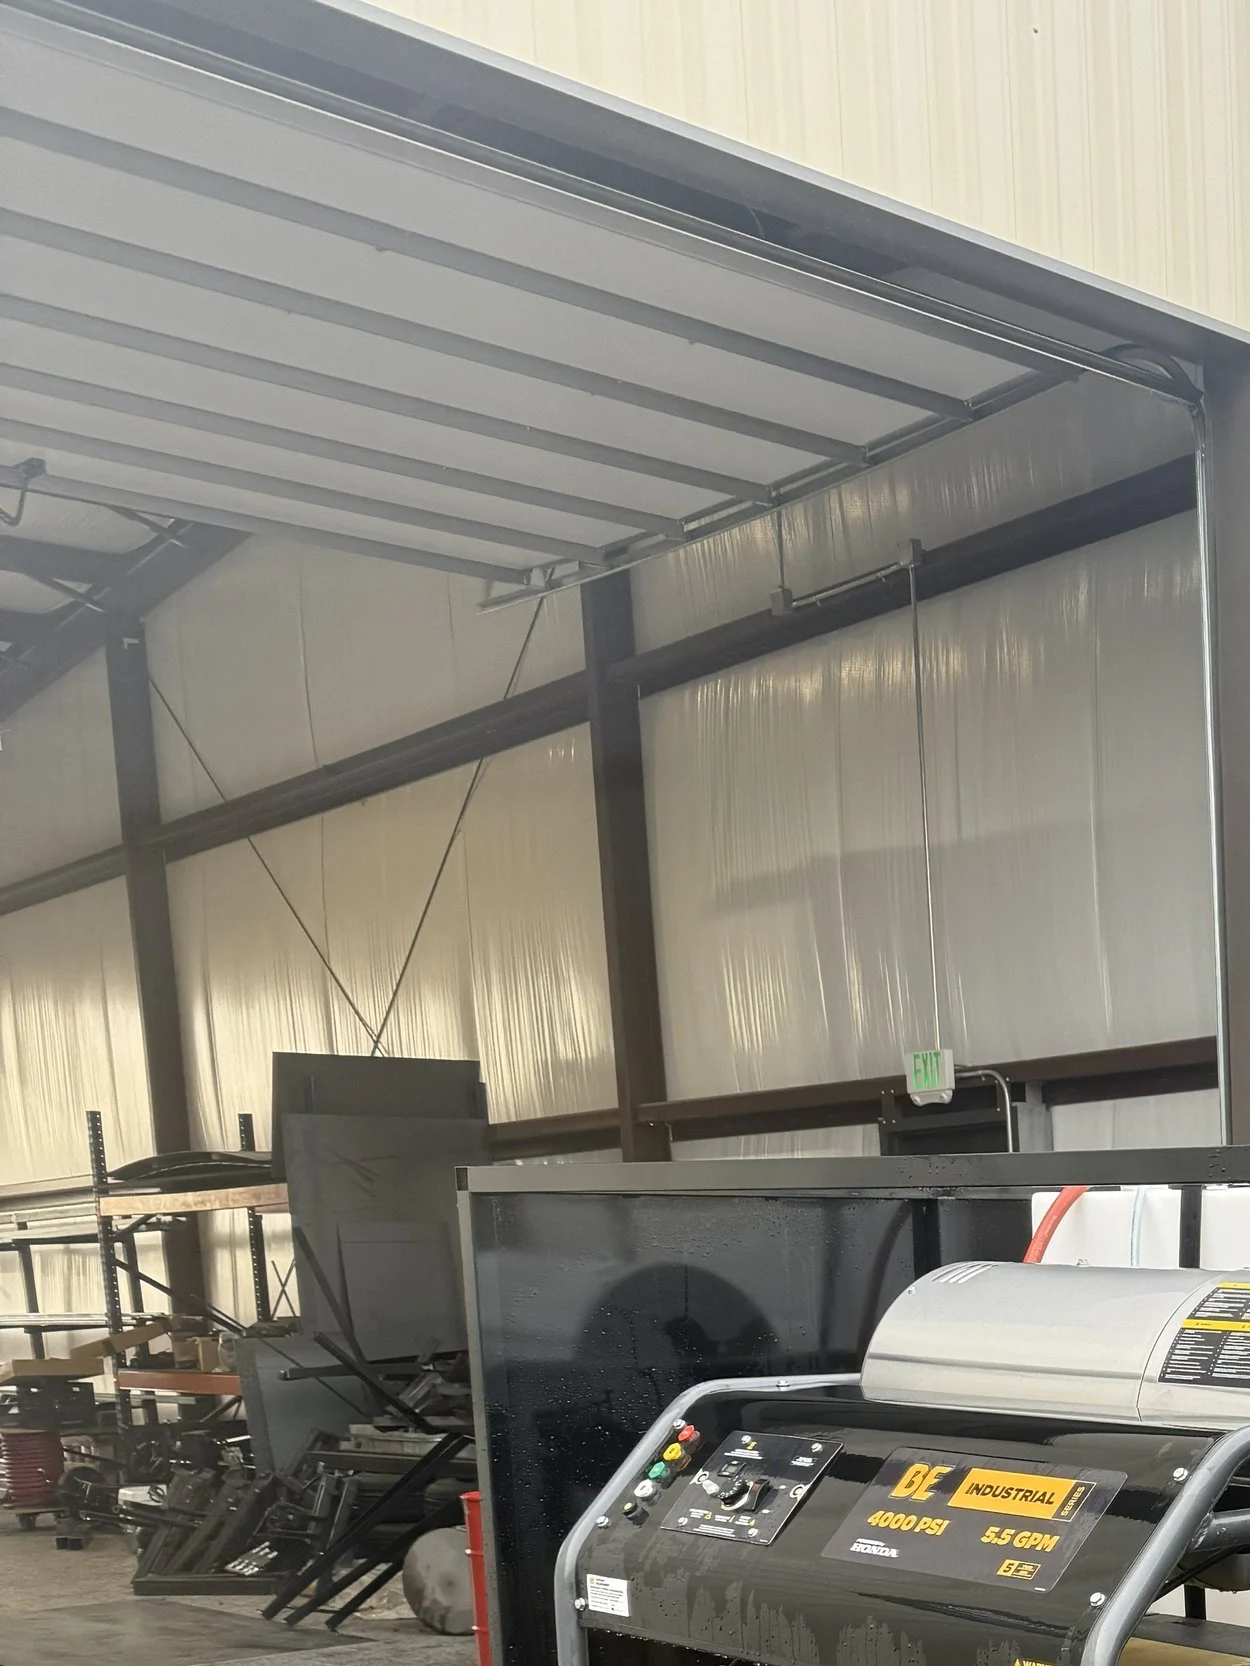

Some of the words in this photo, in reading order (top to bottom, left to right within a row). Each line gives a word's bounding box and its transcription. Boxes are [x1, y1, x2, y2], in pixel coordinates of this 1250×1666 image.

[913, 1051, 941, 1089] EXIT
[889, 1461, 956, 1502] BE
[965, 1482, 1055, 1506] INDUSTRIAL
[1060, 1486, 1085, 1516] SERIES
[867, 1510, 917, 1531] 4000
[914, 1517, 950, 1536] PSI
[850, 1542, 899, 1558] HONDA
[980, 1526, 1016, 1546] 5.5
[1013, 1531, 1060, 1552] GPM
